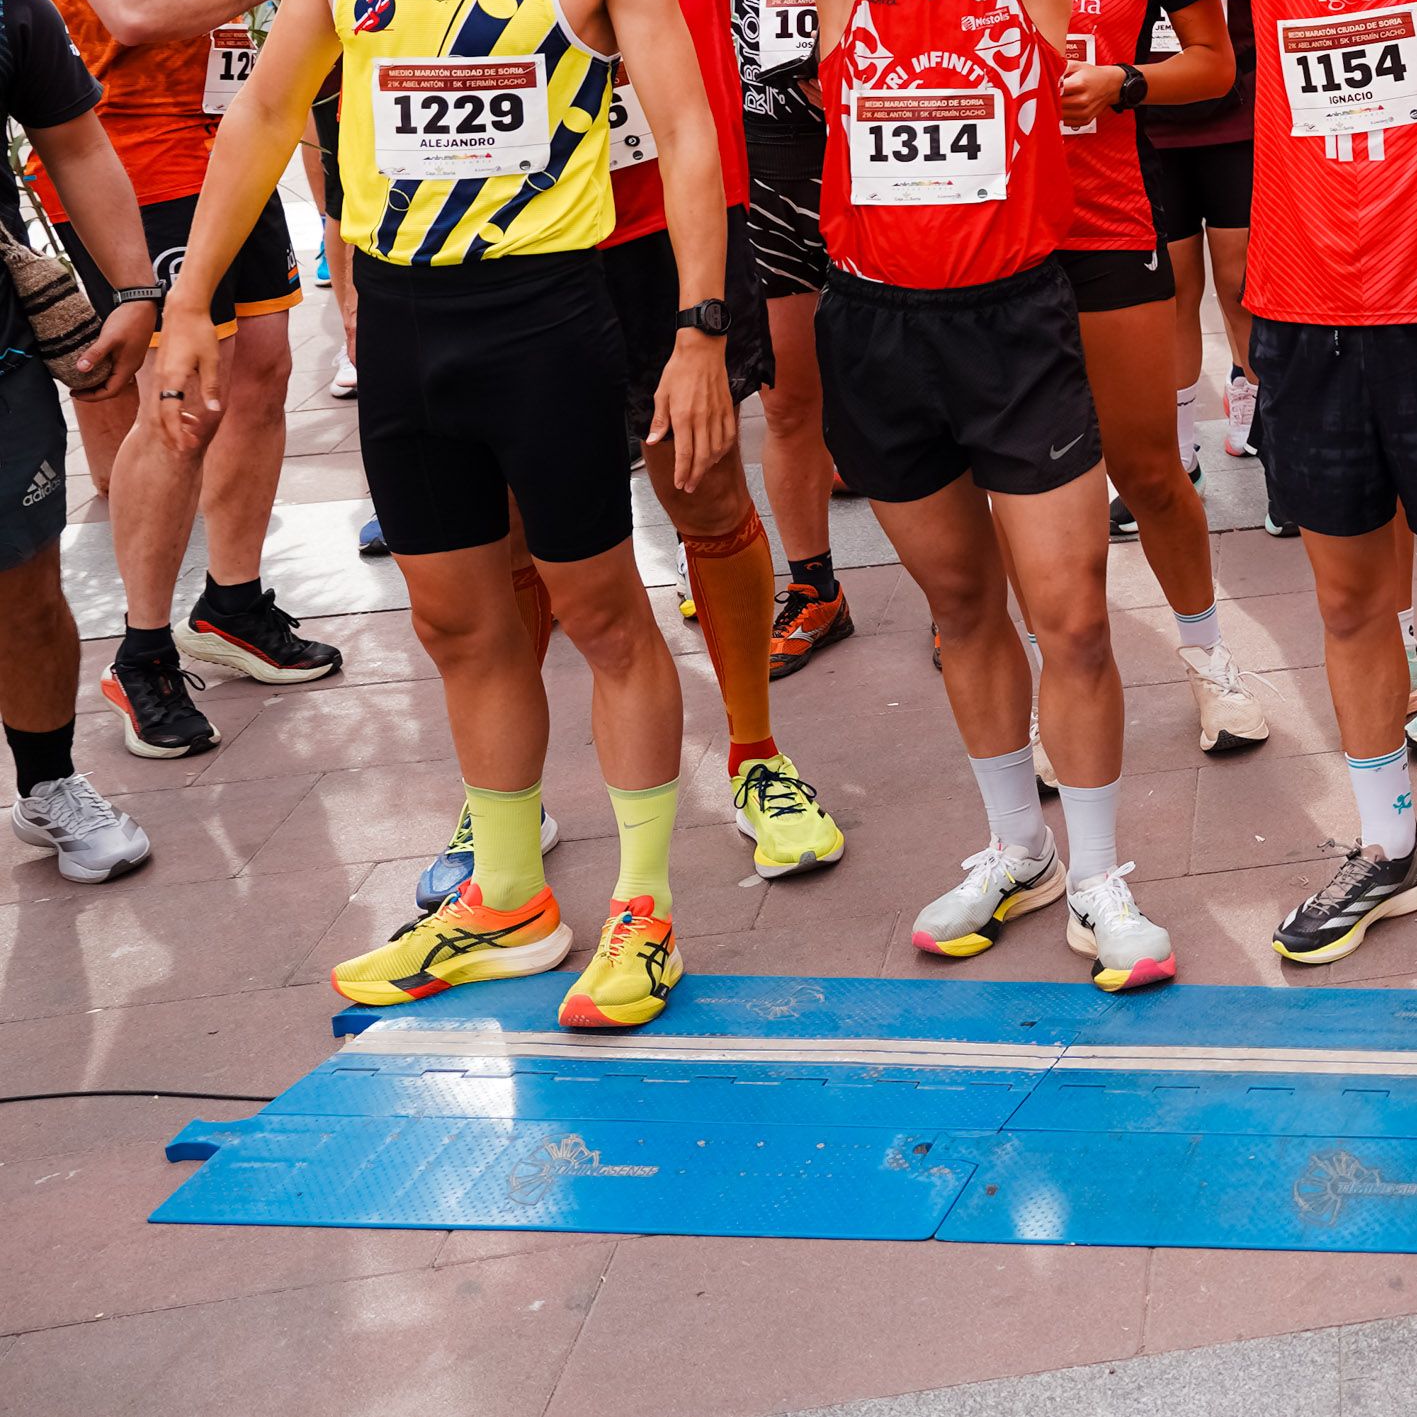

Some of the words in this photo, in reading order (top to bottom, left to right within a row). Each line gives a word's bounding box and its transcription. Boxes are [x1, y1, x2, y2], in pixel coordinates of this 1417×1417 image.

[1338, 24, 1366, 34] CIUDAD
[1379, 17, 1402, 28] SORIA
[1340, 36, 1349, 44] 5K
[1352, 31, 1379, 42] FERMÍN
[1380, 28, 1406, 38] CACHO
[415, 67, 450, 76] MARATÓN
[484, 68, 496, 76] DE
[498, 67, 524, 75] SORIA
[1296, 44, 1407, 93] 1154
[402, 80, 420, 88] ABEL
[421, 79, 444, 88] ANTÓN
[466, 79, 497, 87] FERMÍN
[498, 77, 526, 86] CACHO
[884, 99, 918, 107] MARATÓN
[961, 98, 984, 106] SORIA
[1329, 91, 1373, 104] IGNACIO
[394, 93, 524, 134] 1229
[890, 110, 913, 118] ANTÓN
[932, 109, 960, 117] FERMÍN
[420, 137, 495, 148] ALEJANDRO
[869, 124, 981, 162] 1314
